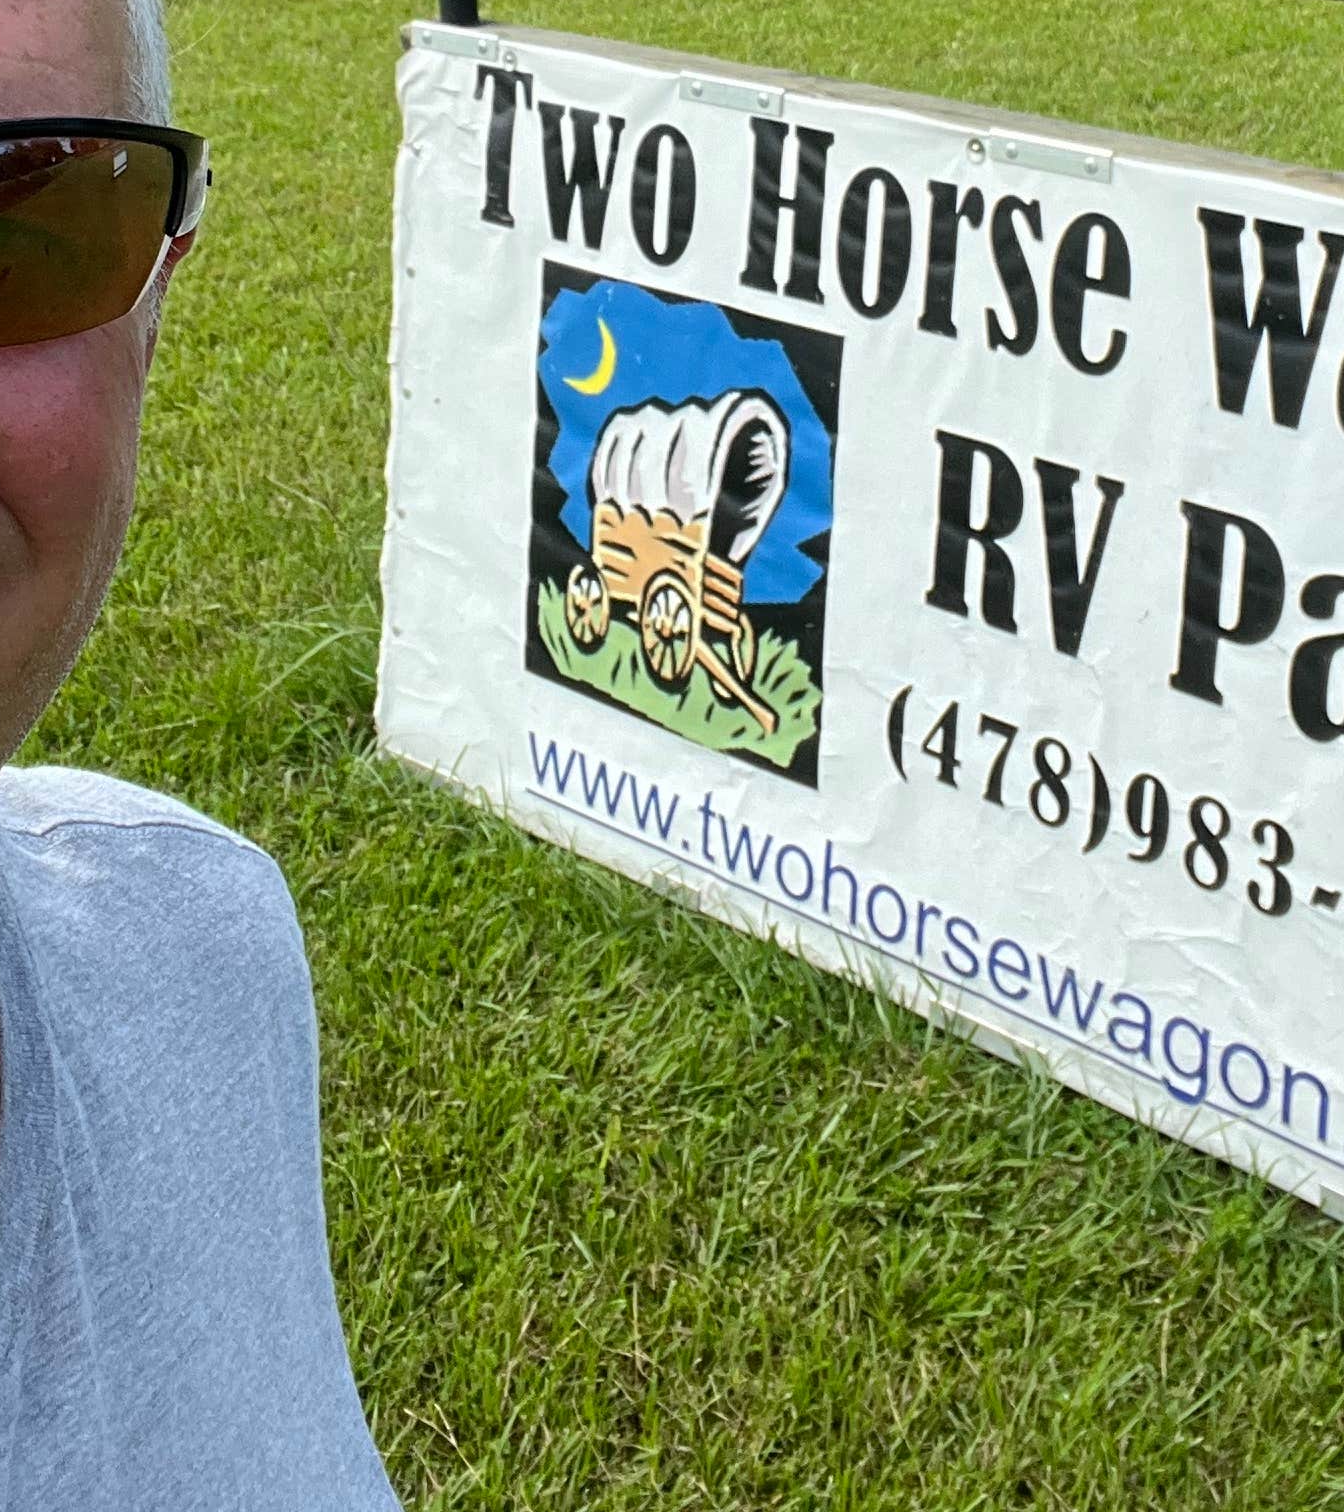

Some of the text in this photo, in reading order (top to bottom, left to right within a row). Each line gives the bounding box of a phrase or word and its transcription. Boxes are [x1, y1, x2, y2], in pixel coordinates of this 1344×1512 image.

[474, 64, 698, 267] Two
[739, 117, 1132, 376] Horse
[926, 430, 1125, 659] RV
